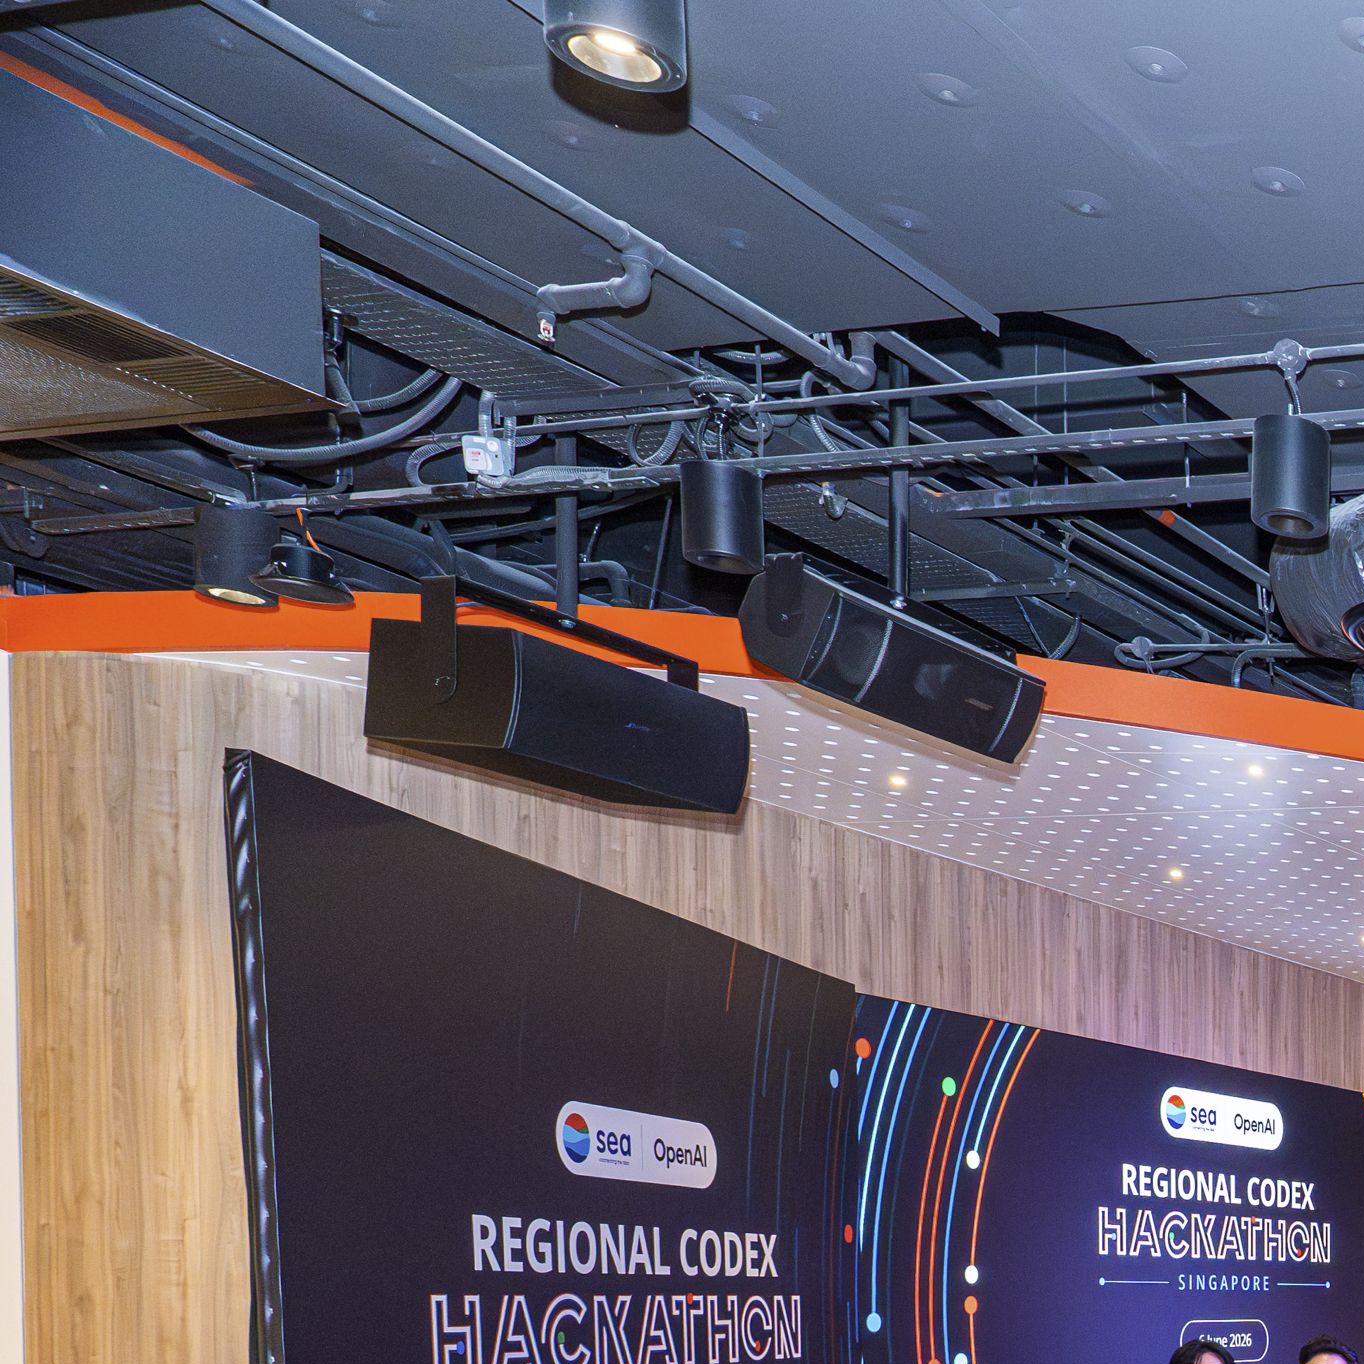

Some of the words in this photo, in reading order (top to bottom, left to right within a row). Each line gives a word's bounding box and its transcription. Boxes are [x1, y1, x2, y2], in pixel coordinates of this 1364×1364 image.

[1190, 1106, 1217, 1126] sea
[1234, 1113, 1275, 1135] OpenAI
[596, 1129, 631, 1157] sea
[654, 1138, 707, 1168] OpenAI
[1122, 1163, 1242, 1205] REGIONAL
[1247, 1177, 1315, 1210] CODEX
[472, 1214, 670, 1275] REGIONAL
[680, 1229, 778, 1277] CODEX
[1098, 1206, 1331, 1263] HACKATHON
[1178, 1274, 1270, 1291] SINGAPORE
[1229, 1333, 1252, 1348] 2026
